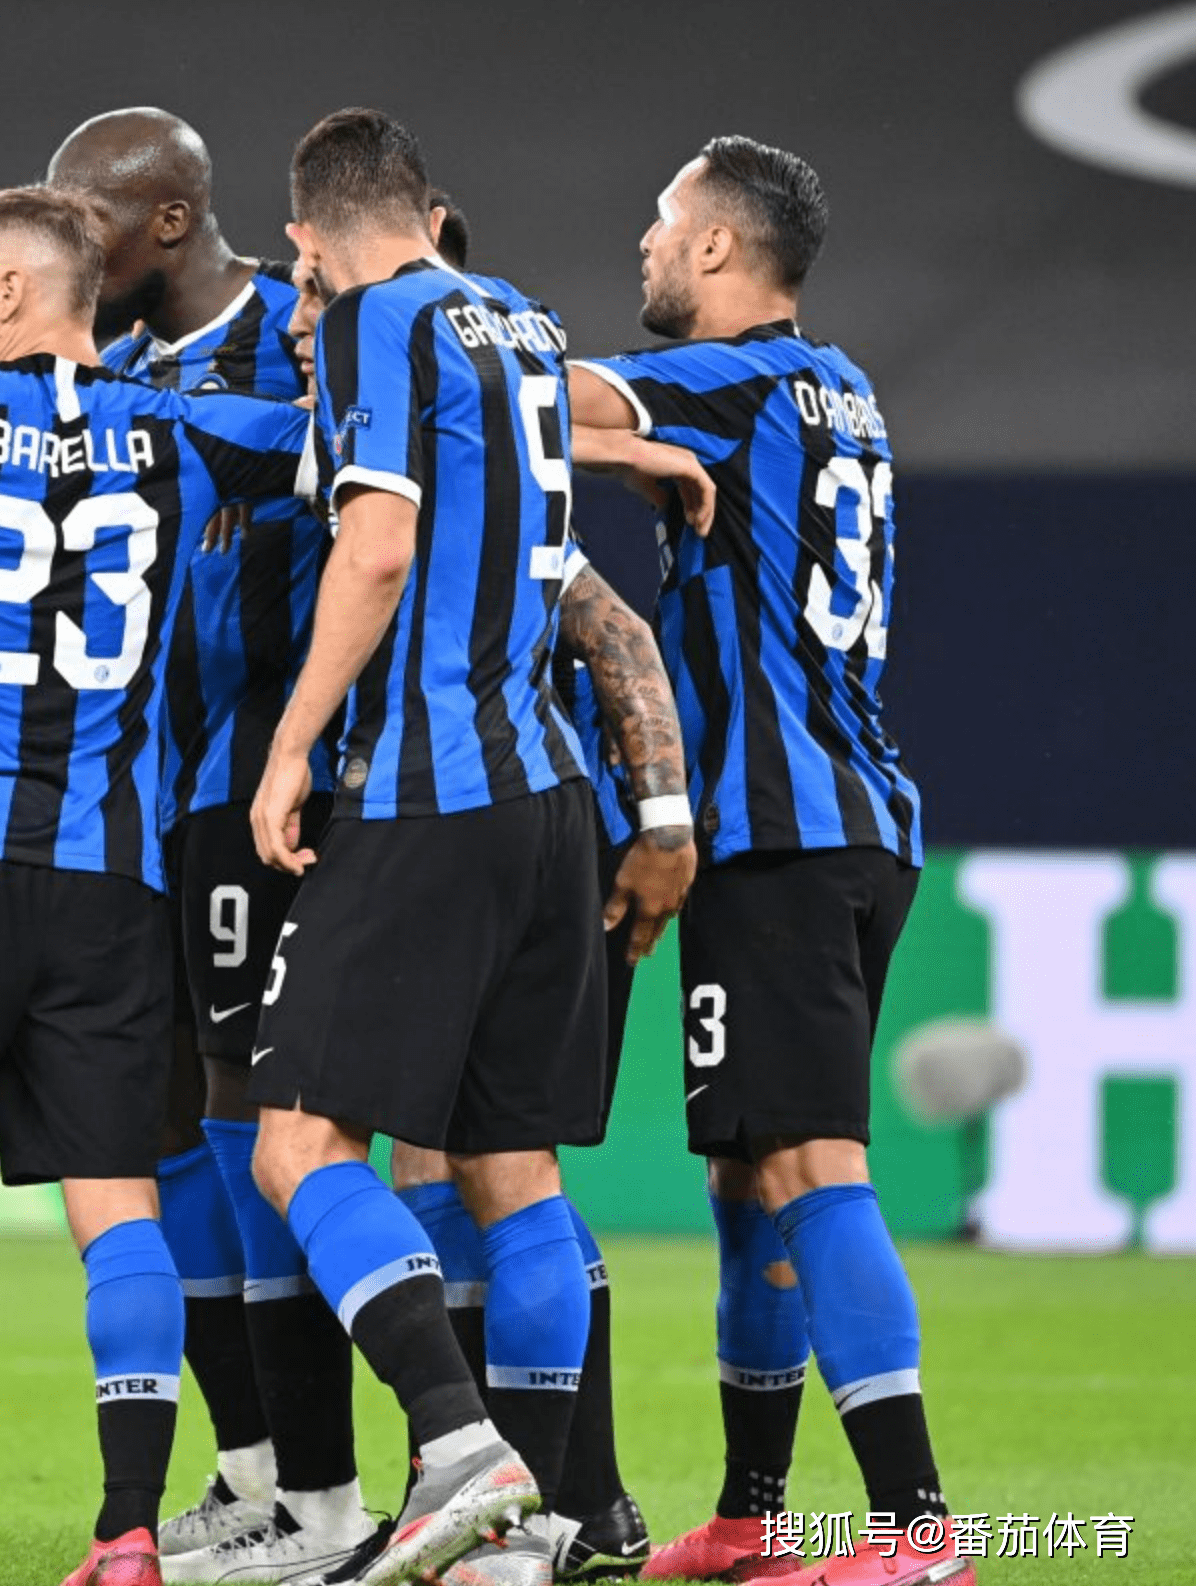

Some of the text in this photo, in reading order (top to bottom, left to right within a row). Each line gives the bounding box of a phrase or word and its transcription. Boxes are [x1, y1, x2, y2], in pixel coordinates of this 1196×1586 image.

[518, 375, 572, 580] 5
[209, 885, 249, 968] 9
[689, 983, 727, 1068] 3
